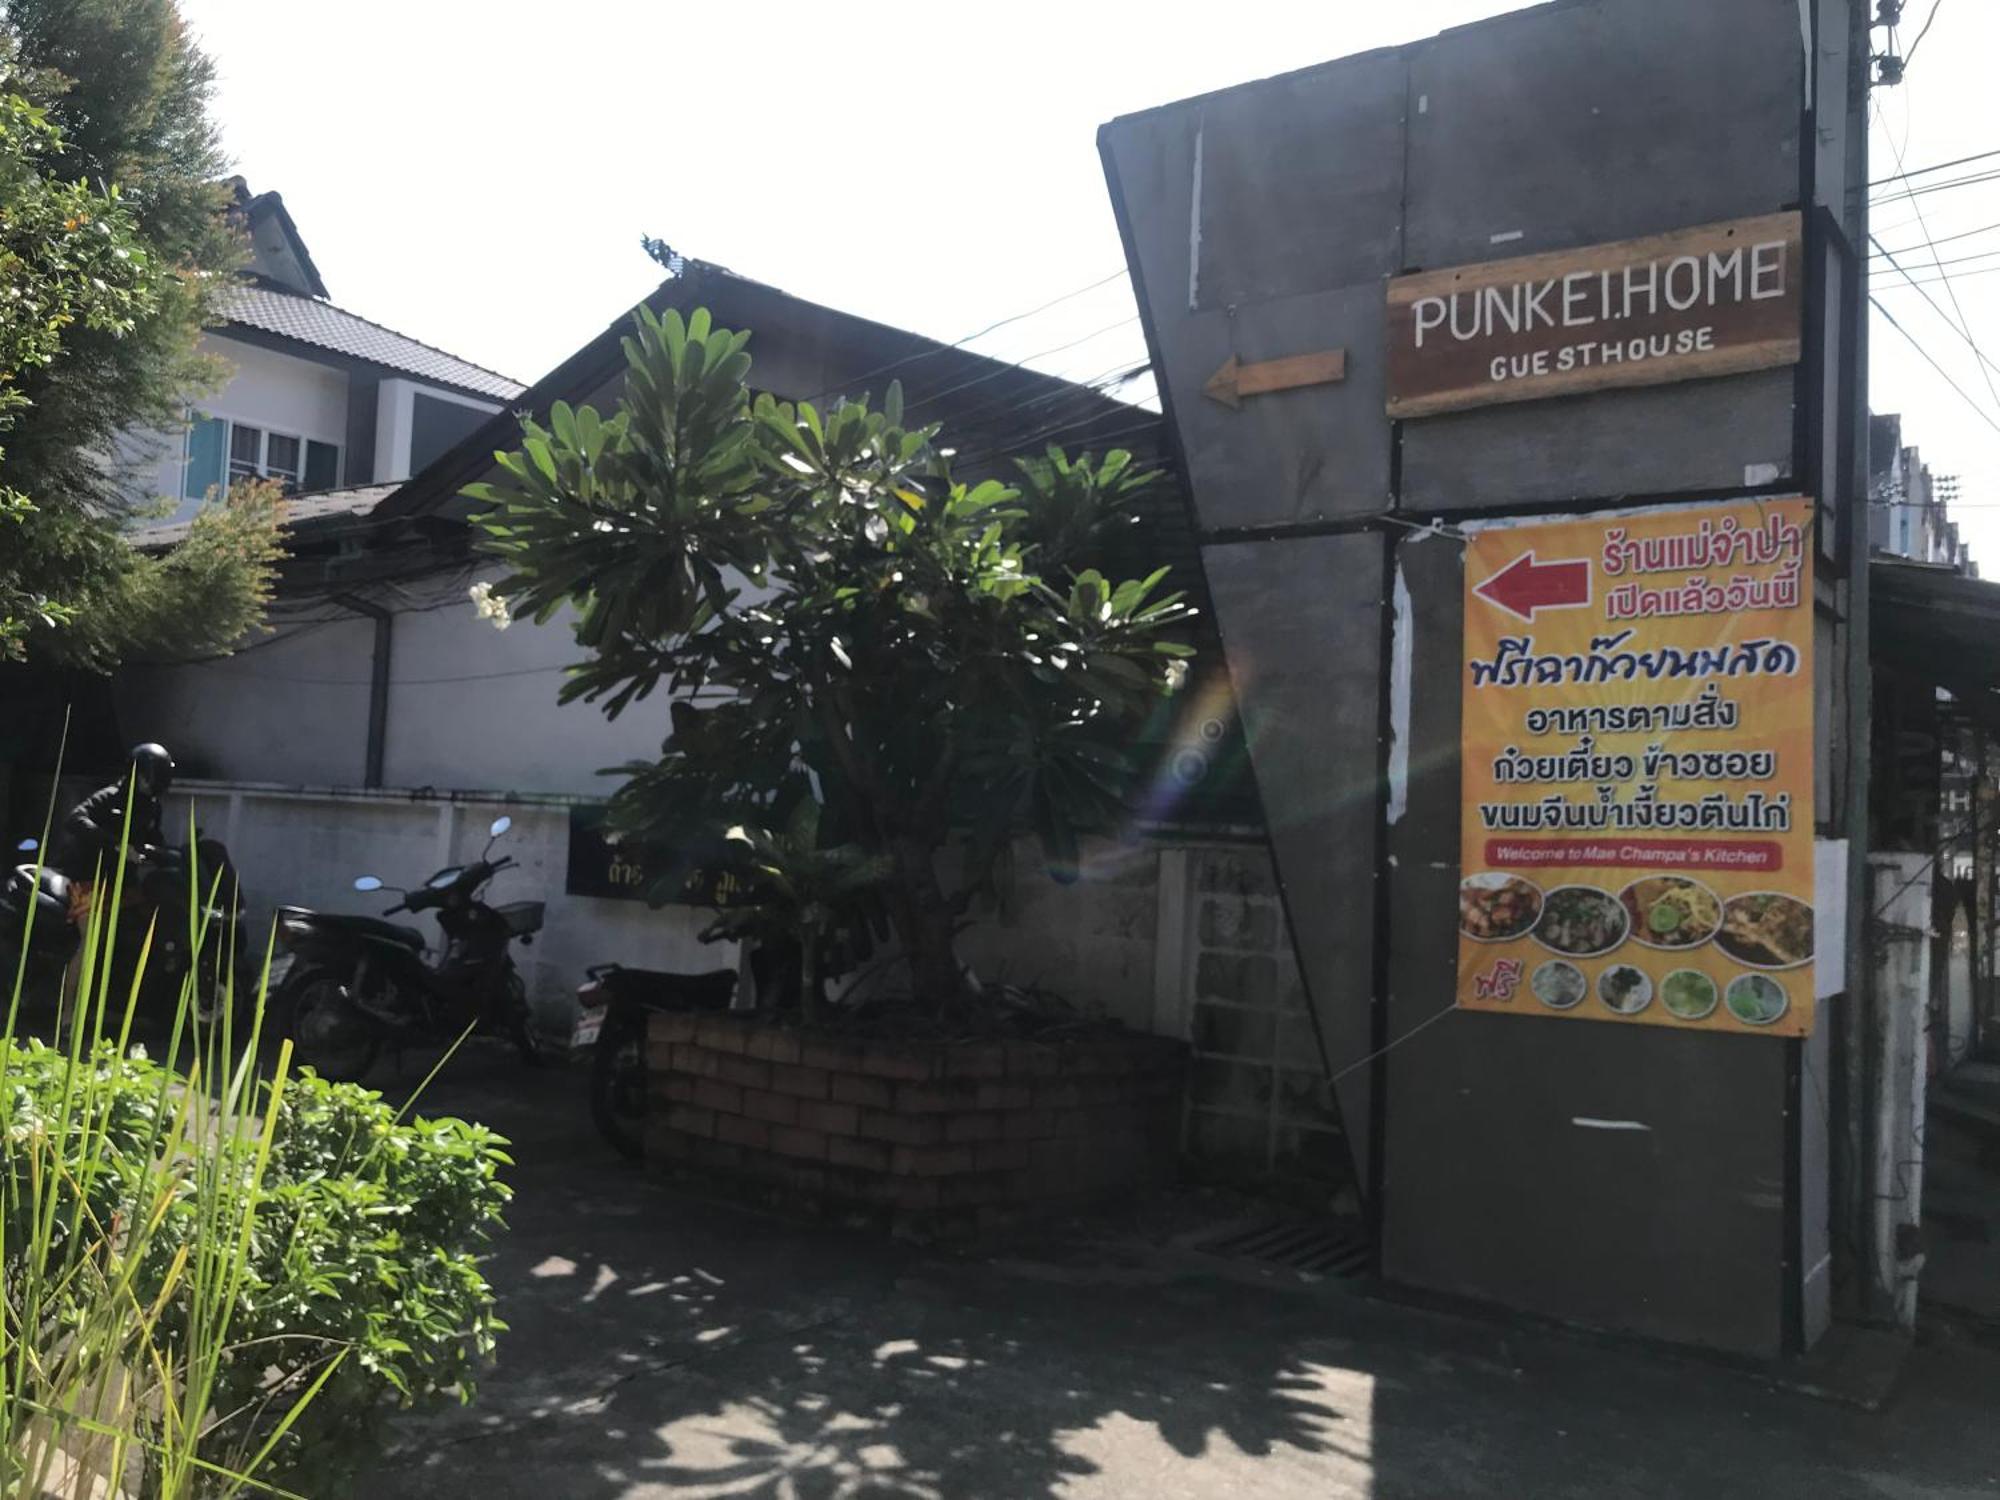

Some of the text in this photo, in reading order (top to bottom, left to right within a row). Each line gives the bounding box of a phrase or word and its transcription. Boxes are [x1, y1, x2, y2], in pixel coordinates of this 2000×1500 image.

[1490, 326, 1715, 381] GUESTHOUSE
[1603, 513, 1801, 576] ร้านแม่จำปา
[1606, 561, 1799, 619] เปิดแล้ววันนี้
[1527, 684, 1736, 733] อาหารตามสั่ง
[1494, 736, 1775, 782] ก๋วยเตี๋ยว ข้าวซอย
[1480, 785, 1789, 831] ขนมจีนน้ำเงี้ยวตีนไก่
[1496, 846, 1564, 861] Welcome
[1568, 848, 1582, 861] to
[1619, 846, 1700, 863] Champa's
[1703, 848, 1768, 864] Kitchen
[1473, 959, 1520, 998] ฟรี
